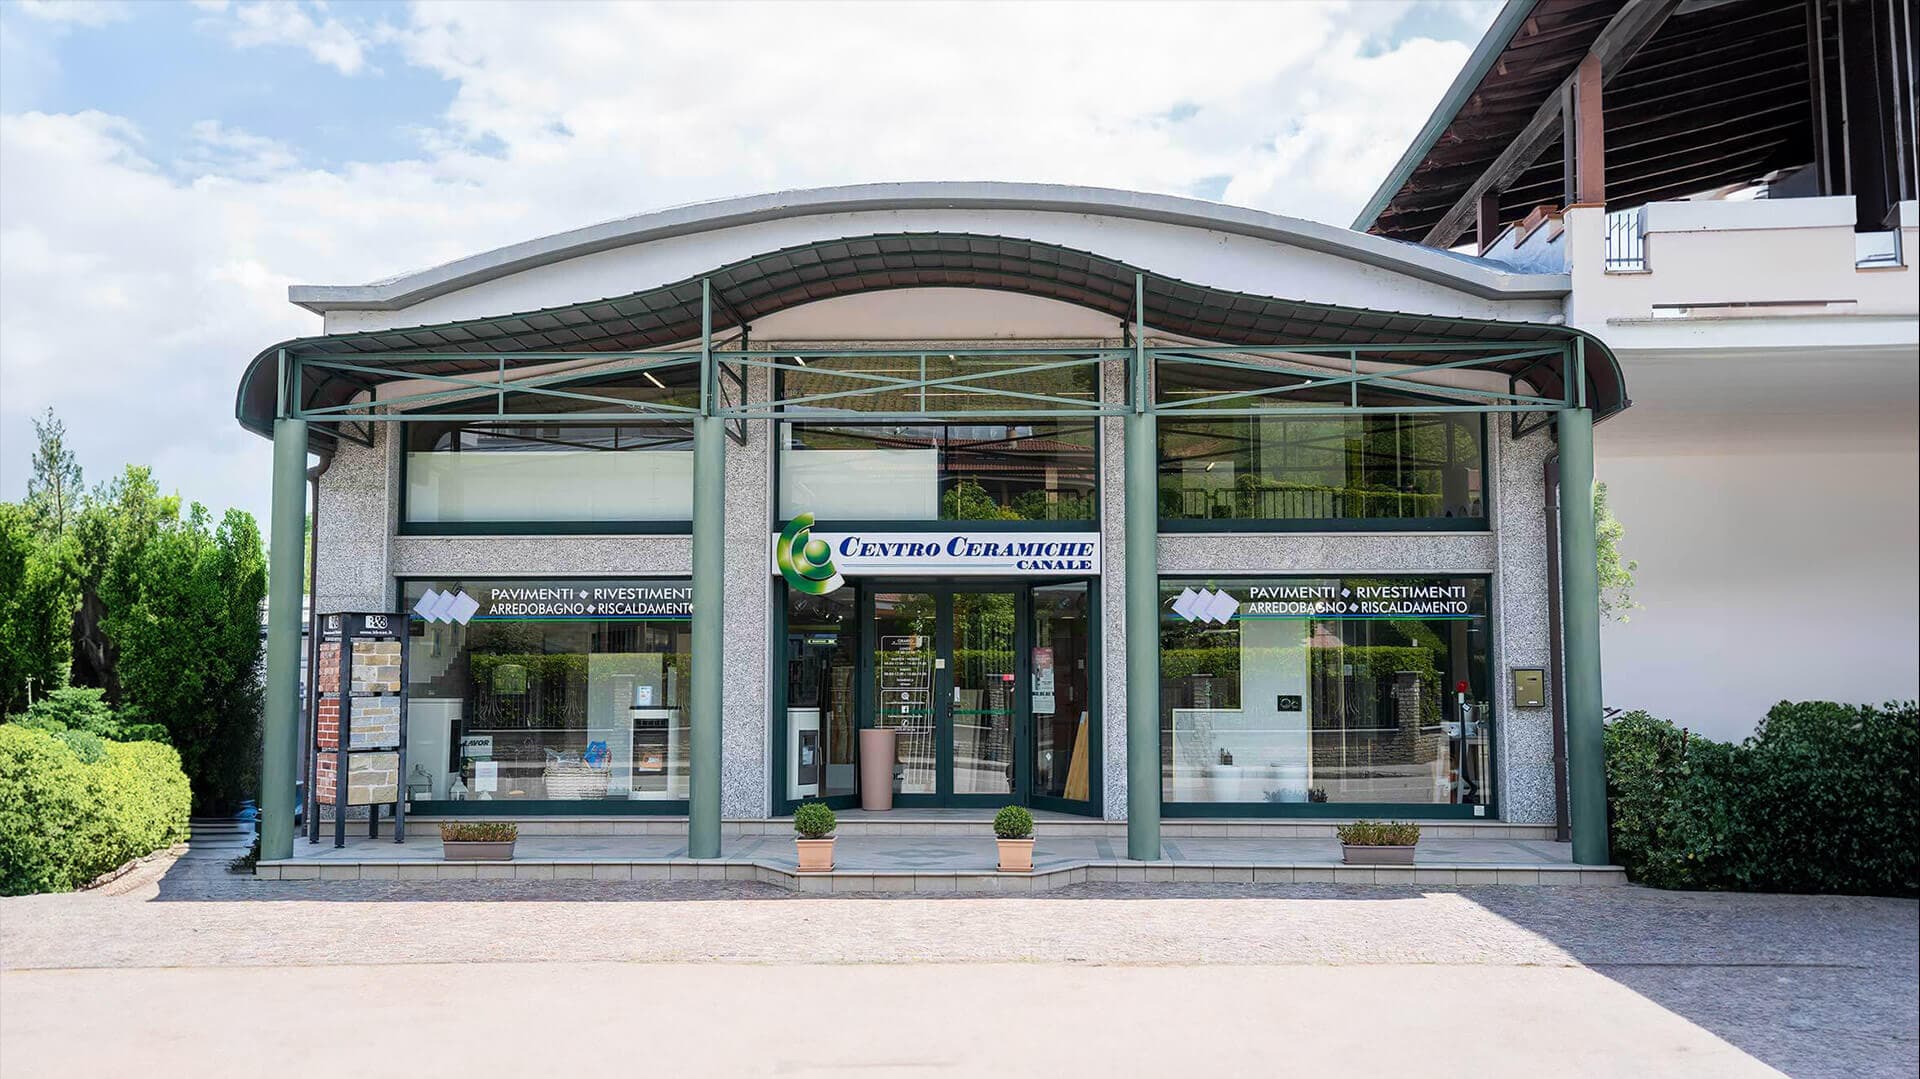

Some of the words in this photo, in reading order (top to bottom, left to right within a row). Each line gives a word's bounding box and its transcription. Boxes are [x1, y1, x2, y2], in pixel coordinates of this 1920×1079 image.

[1016, 560, 1092, 570] CANALE
[491, 588, 574, 600] PAVIMENTI
[594, 588, 693, 600] RIVESTIMENT
[1250, 586, 1335, 599] PAVIMENTI
[1356, 586, 1466, 599] RIVESTIMENTI
[489, 602, 584, 615] ARREDOBAGNO
[1249, 601, 1347, 614] ARREDOBAGNO
[1361, 601, 1468, 614] RISCALDAMENTO
